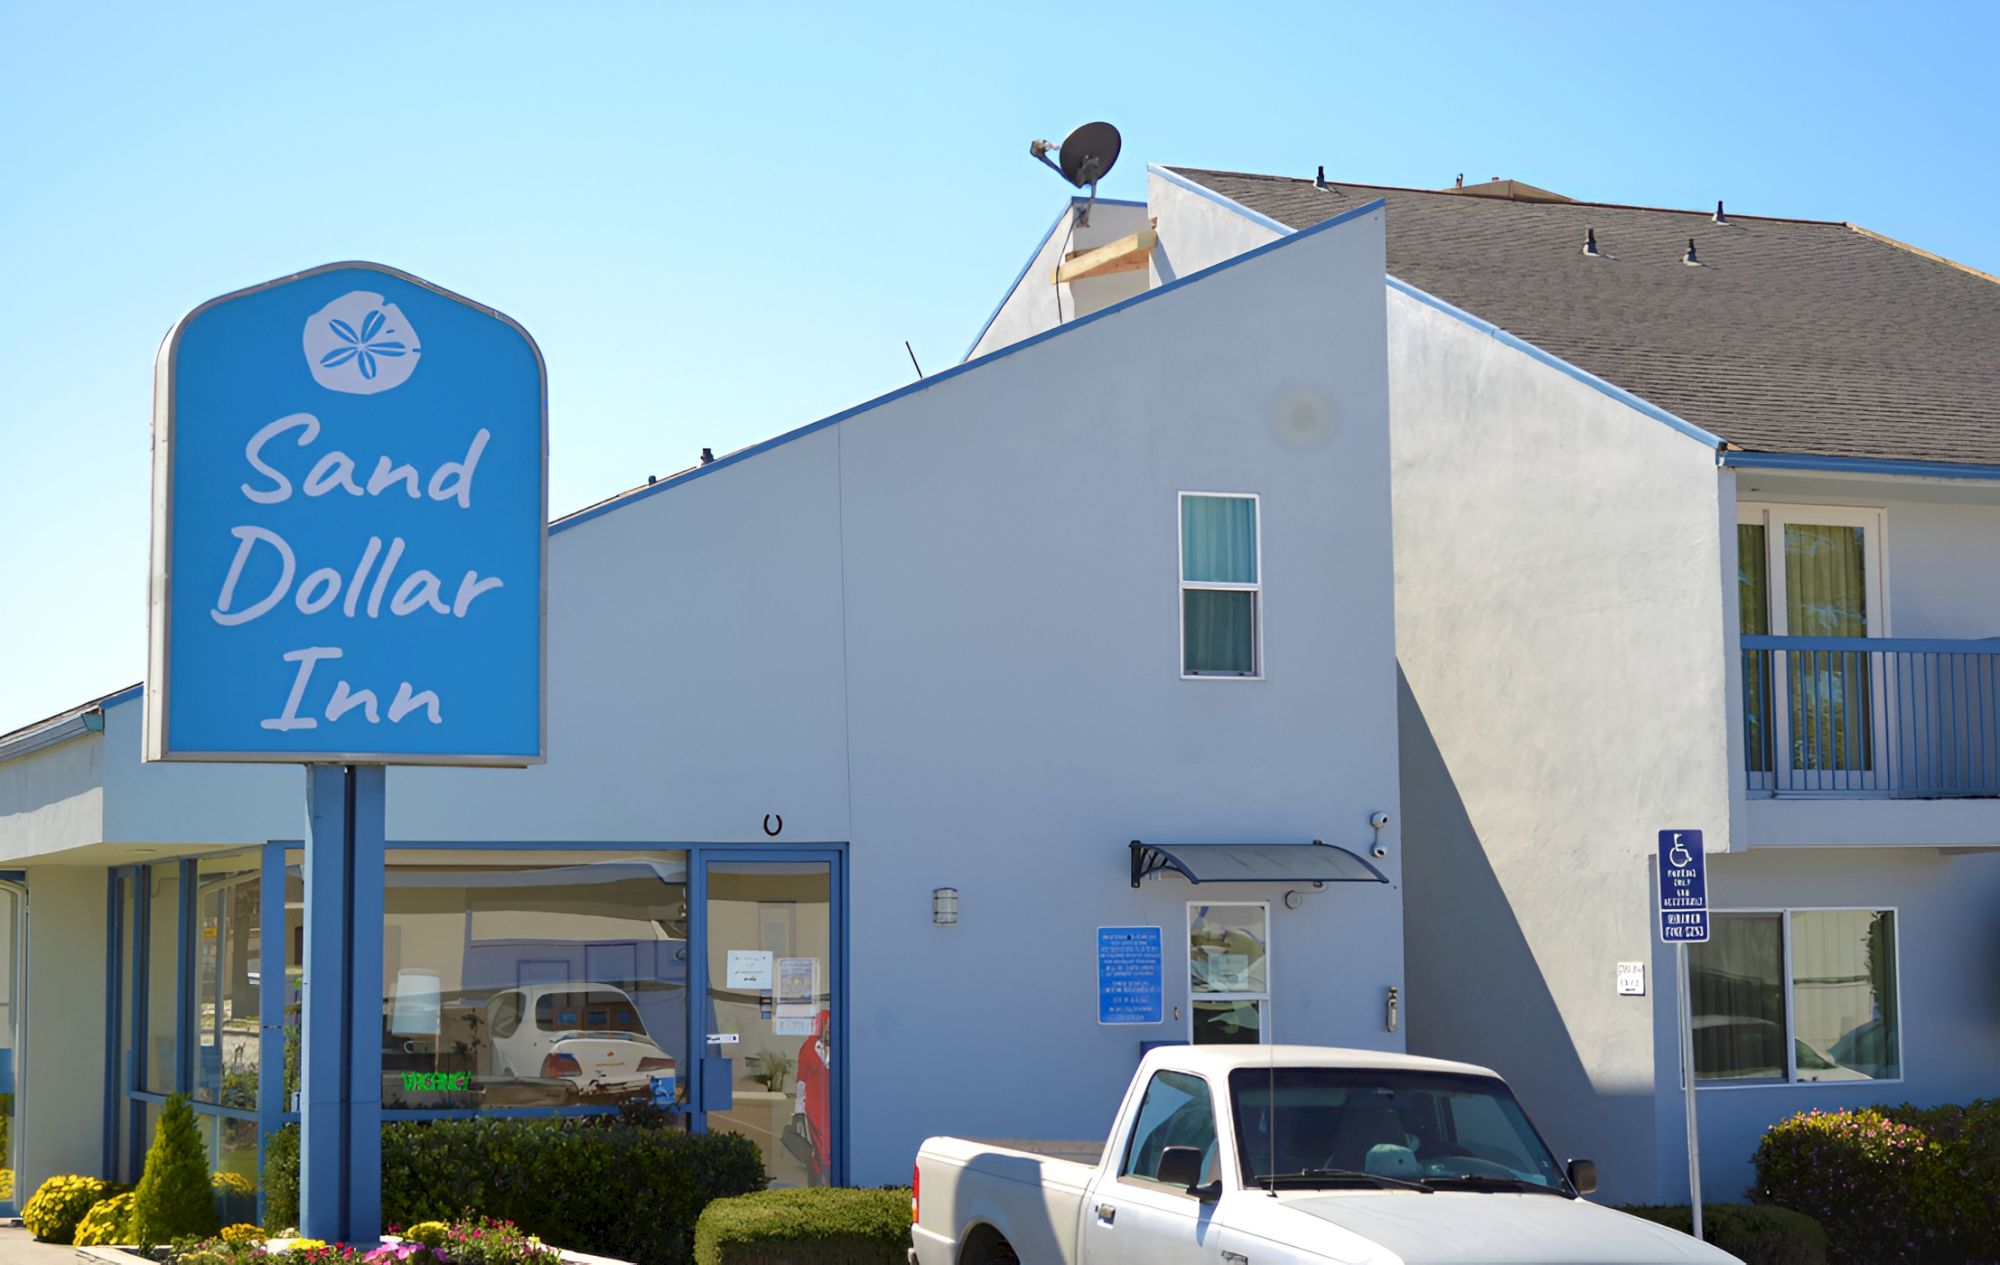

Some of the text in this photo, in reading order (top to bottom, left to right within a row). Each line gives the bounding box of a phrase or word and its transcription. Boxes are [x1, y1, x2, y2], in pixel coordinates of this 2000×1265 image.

[241, 412, 491, 509] Sand
[210, 525, 504, 626] Dollar
[260, 646, 443, 732] Inn
